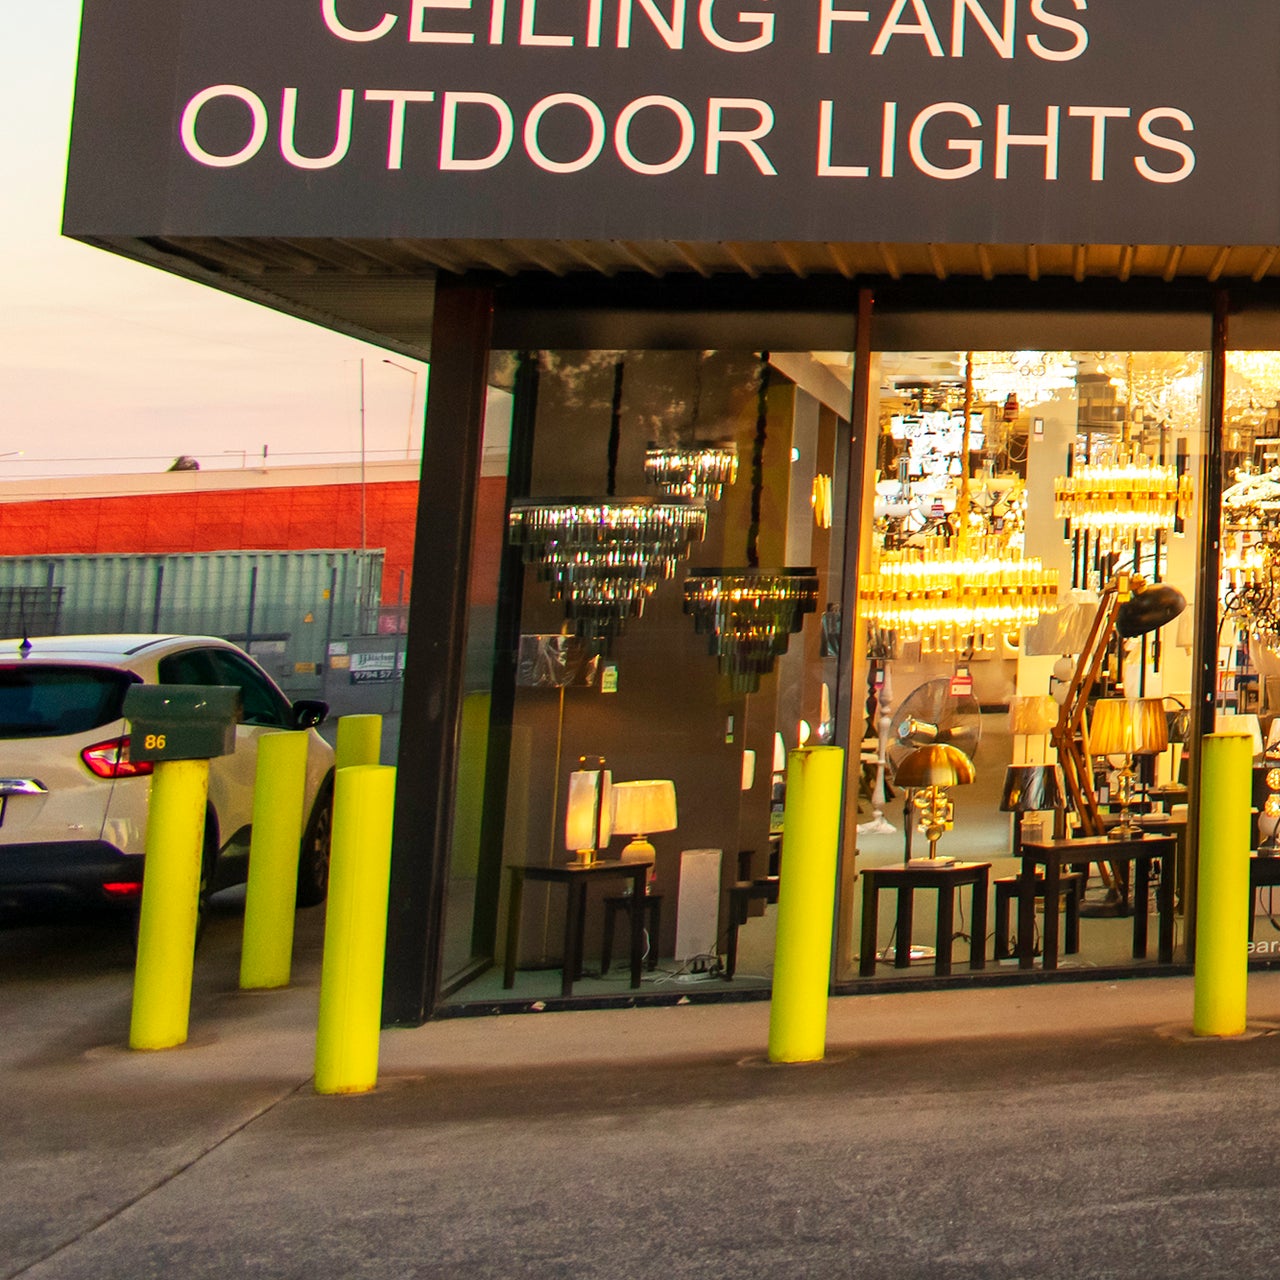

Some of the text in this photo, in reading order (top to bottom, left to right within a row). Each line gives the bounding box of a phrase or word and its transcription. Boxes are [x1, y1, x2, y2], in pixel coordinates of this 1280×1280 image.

[180, 84, 1197, 184] OUTDOOR LIGHTS
[145, 734, 166, 750] 86
